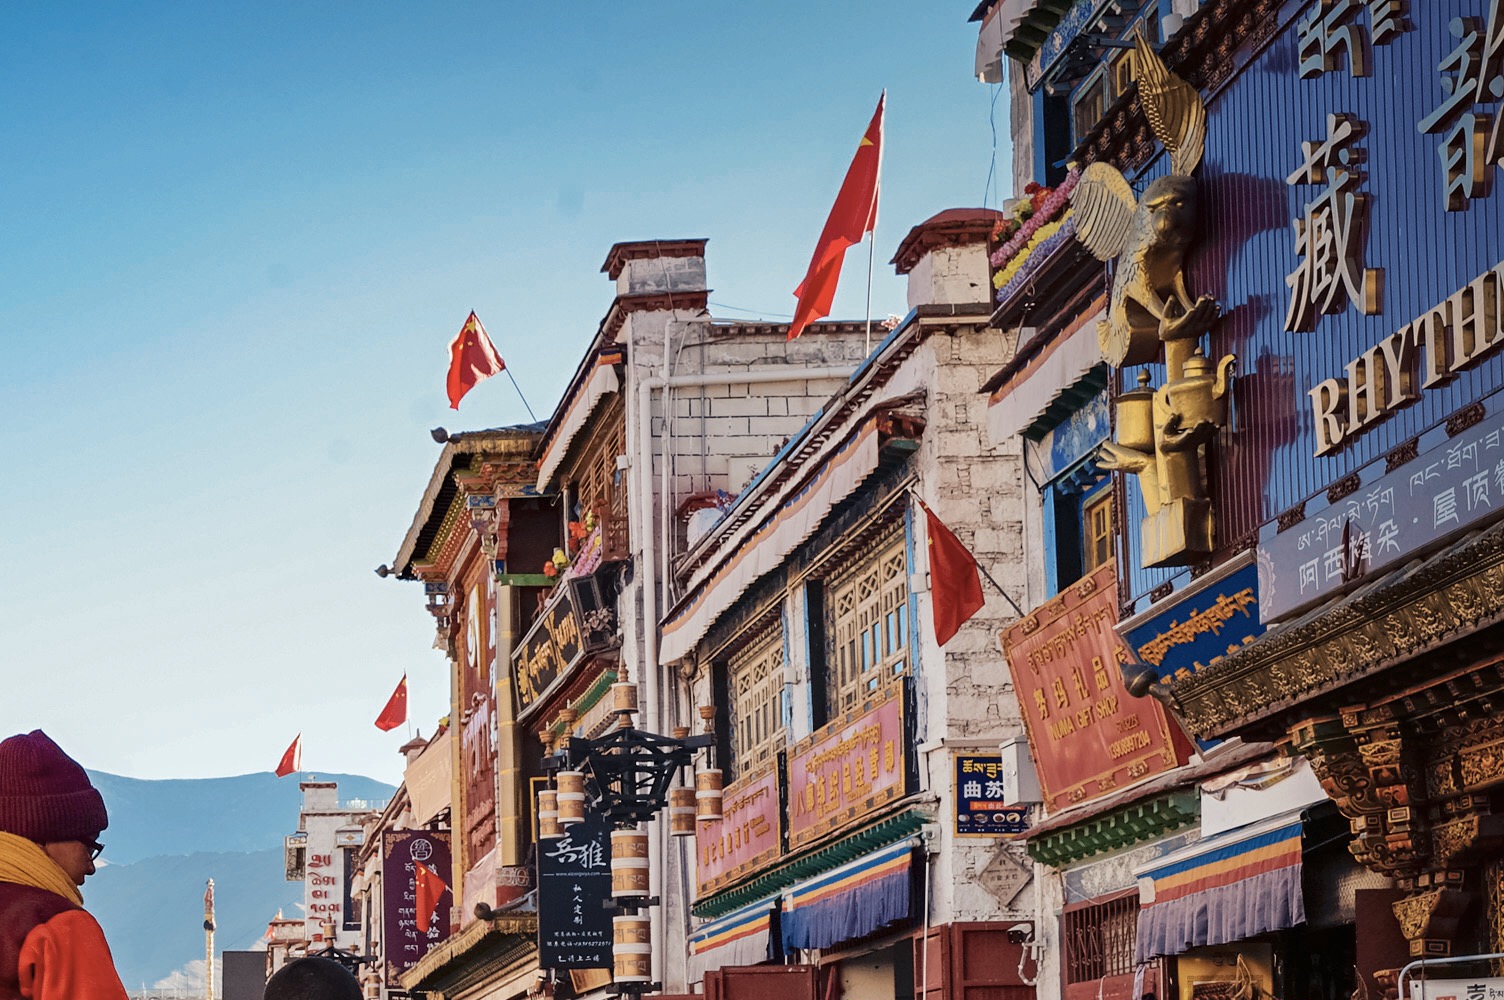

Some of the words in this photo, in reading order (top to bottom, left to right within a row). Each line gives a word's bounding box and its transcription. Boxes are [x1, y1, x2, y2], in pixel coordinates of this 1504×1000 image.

[1050, 717, 1074, 742] NUMA
[1076, 706, 1096, 729] GIFT
[1096, 694, 1118, 720] SHOP
